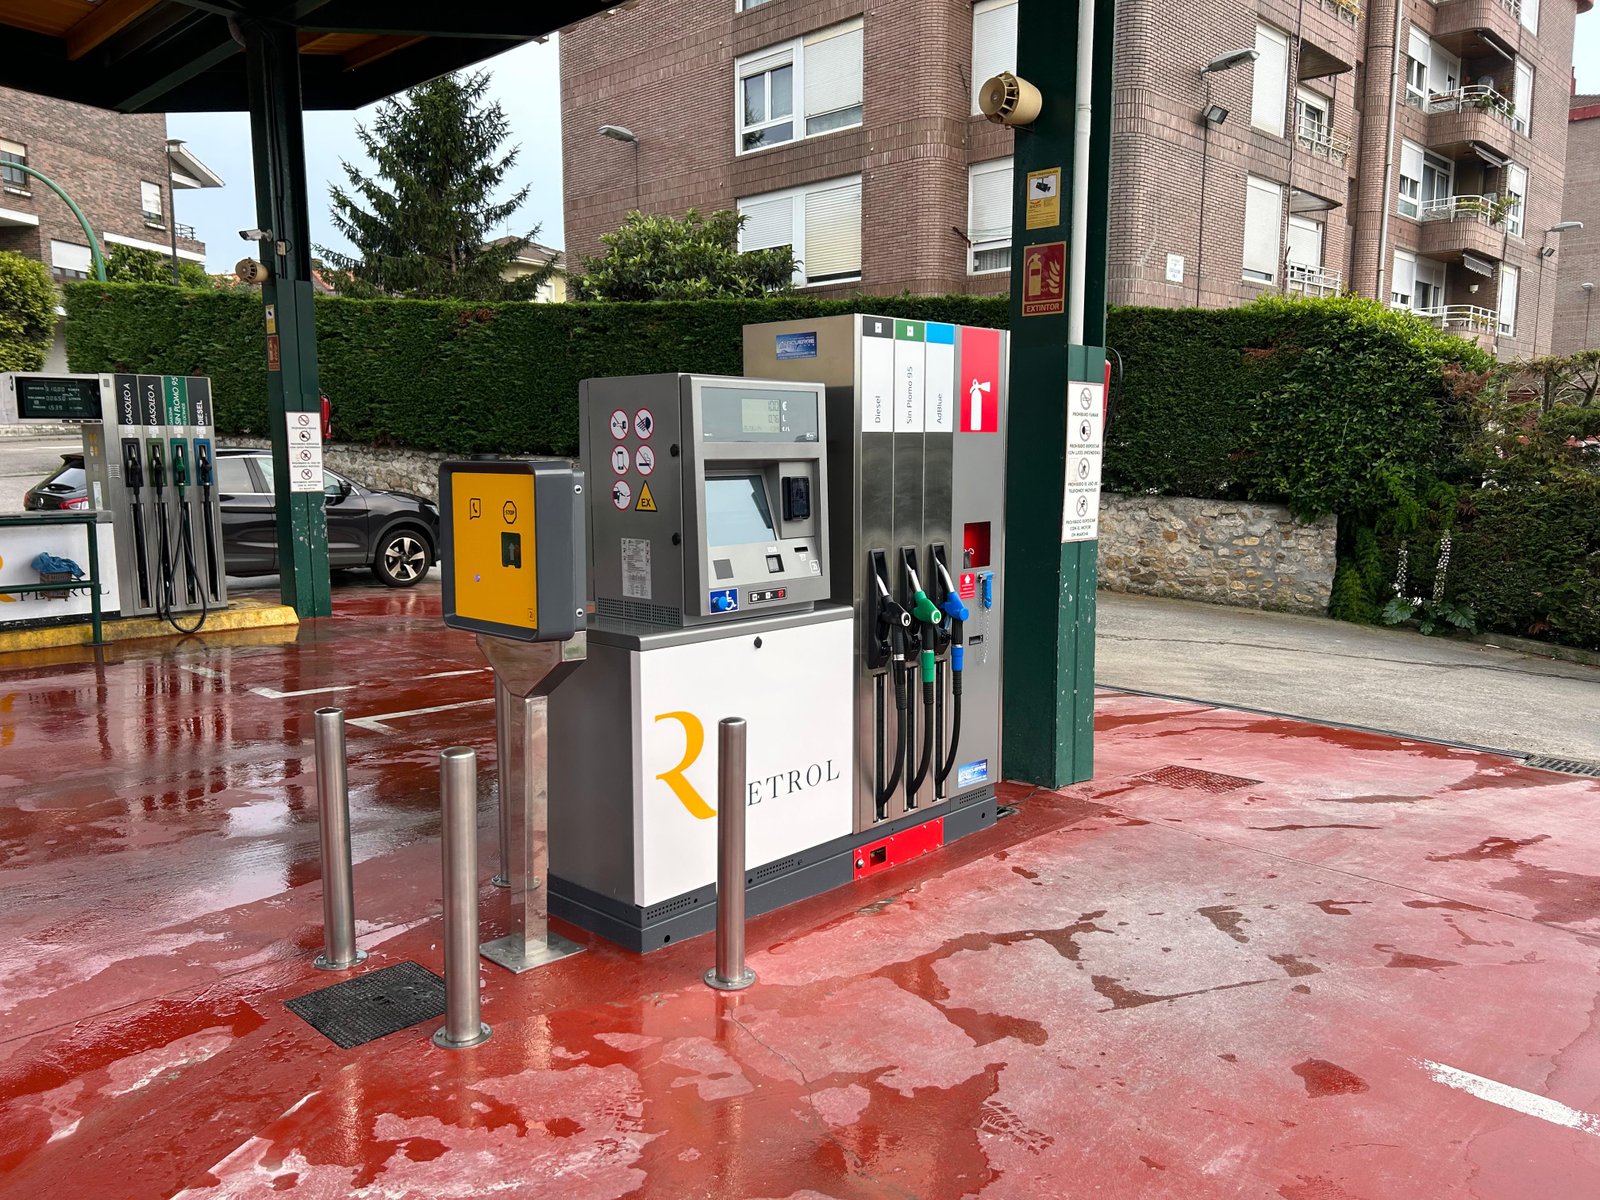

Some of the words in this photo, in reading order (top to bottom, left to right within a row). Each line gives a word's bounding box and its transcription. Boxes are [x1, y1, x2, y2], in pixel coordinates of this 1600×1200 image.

[1026, 303, 1060, 313] EXTINTOR
[171, 376, 179, 386] 95
[907, 366, 913, 378] 95
[9, 375, 15, 392] 3
[123, 390, 134, 425] GASOLEO
[148, 391, 158, 426] GASOLEO
[172, 387, 181, 412] PLOMO
[196, 400, 204, 426] DIESEL
[640, 497, 651, 508] EX
[747, 760, 840, 806] ETROL
